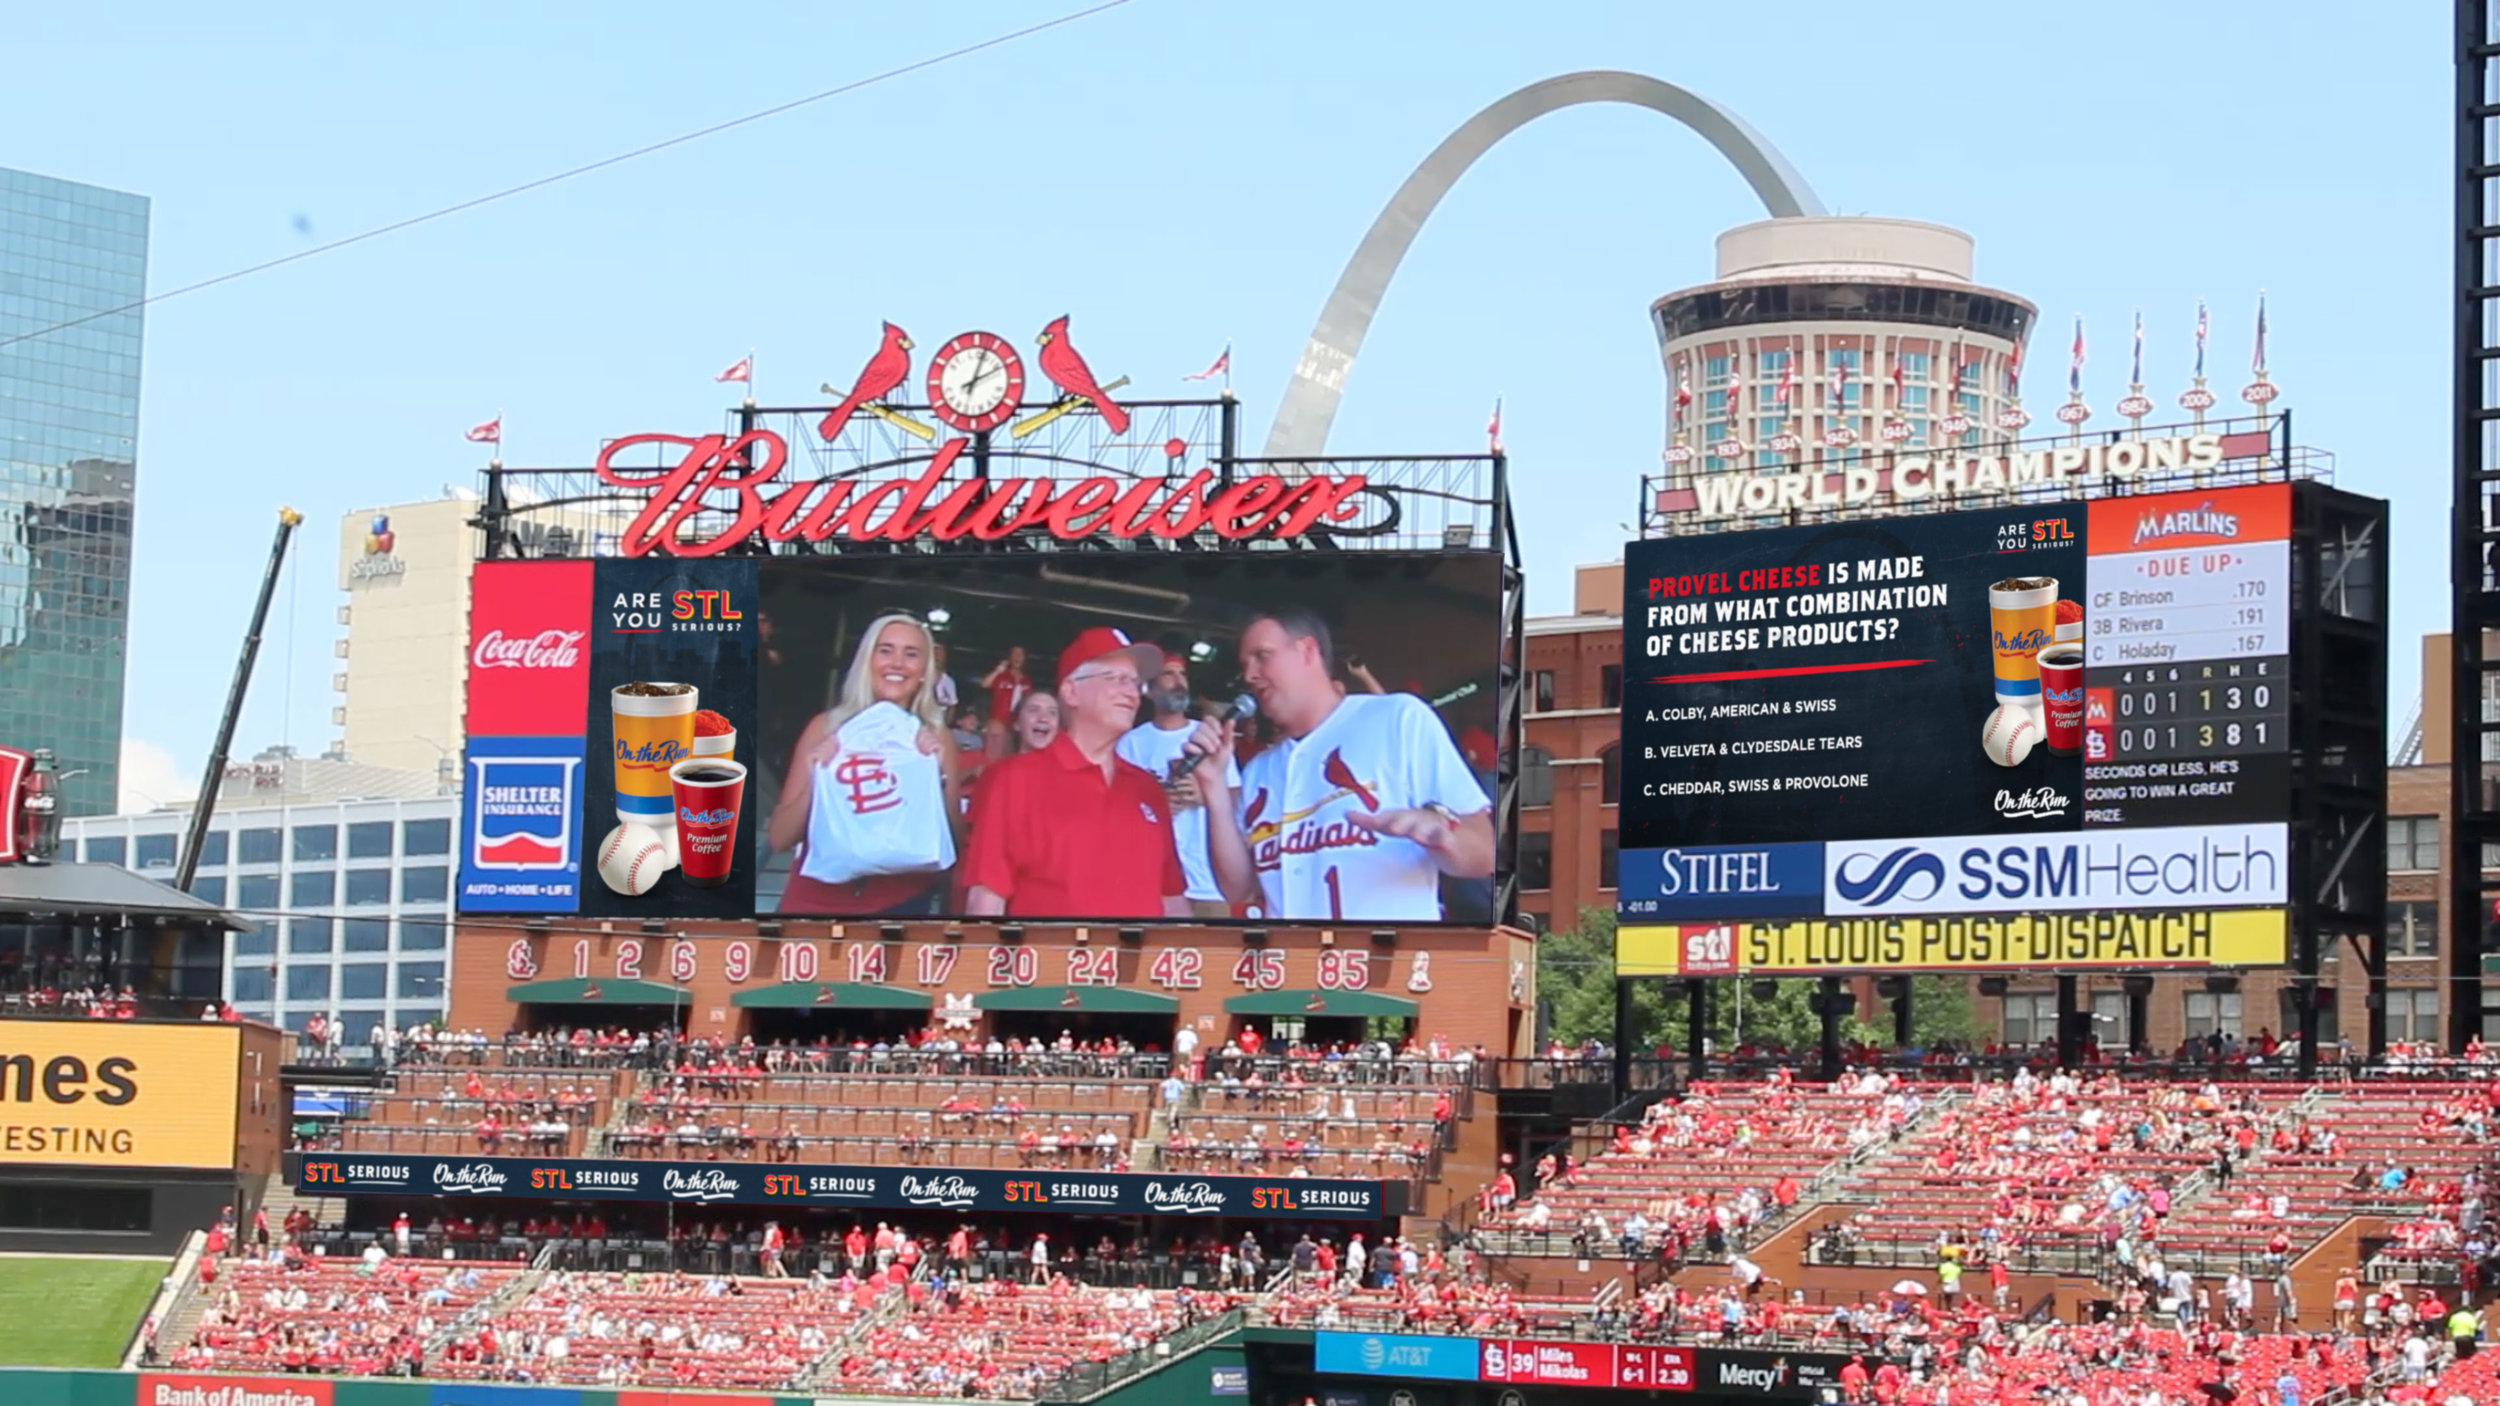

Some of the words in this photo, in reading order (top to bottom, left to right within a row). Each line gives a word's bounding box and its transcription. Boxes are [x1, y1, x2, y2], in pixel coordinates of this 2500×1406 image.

[2246, 386, 2272, 400] 2011
[1693, 467, 1879, 517] WORLD
[1892, 433, 2224, 499] CHAMPIONS
[596, 429, 1367, 558] Budweiser
[1998, 523, 2026, 536] ARE
[2032, 518, 2074, 541] STL
[2133, 508, 2239, 545] MARLINS
[1997, 537, 2026, 550] YOU
[2032, 540, 2074, 550] SERIOUS?
[1649, 571, 1732, 599] PROVEL
[1738, 564, 1820, 591] CHEESE
[1827, 562, 1849, 585] IS
[1857, 555, 1924, 582] MADE
[2148, 557, 2190, 578] DUE
[2203, 553, 2232, 573] UP
[613, 593, 661, 608] ARE
[672, 590, 742, 619] STL
[1647, 602, 1707, 628] FROM
[1715, 597, 1780, 622] WHAT
[1786, 583, 1948, 617] COMBINATION
[2094, 592, 2113, 608] CF
[2119, 591, 2174, 607] Brinson
[2233, 581, 2266, 598] .170
[612, 612, 661, 629] YOU
[672, 623, 742, 632] SERIOUS?
[2093, 619, 2112, 635] 3B
[2119, 618, 2164, 633] Rivera
[2232, 609, 2264, 625] .191
[1646, 635, 1673, 657] OF
[1679, 628, 1760, 655] CHEESE
[1767, 617, 1900, 648] PRODUCTS?
[2093, 646, 2103, 661] C
[2119, 642, 2176, 660] Holaday
[2232, 635, 2265, 652] .167
[474, 630, 585, 668] Coca-Cola
[2122, 671, 2132, 683] 4
[2146, 670, 2155, 682] 5
[2169, 669, 2178, 681] 6
[2203, 667, 2212, 678] R
[2229, 665, 2240, 677] H
[2258, 663, 2267, 675] E
[1645, 710, 1659, 722] A.
[1662, 706, 1707, 721] COLBY,
[1710, 702, 1780, 719] AMERICAN
[1783, 702, 1792, 713] &
[1795, 699, 1837, 713] SWISS
[2121, 694, 2133, 716] 0
[2144, 692, 2156, 714] 0
[2168, 691, 2176, 713] 1
[2201, 690, 2210, 711] 1
[2227, 687, 2241, 709] 3
[2254, 686, 2269, 708] 0
[1644, 747, 1657, 759] B.
[1661, 743, 1716, 758] VELVETA
[1719, 743, 1728, 755] &
[1732, 738, 1816, 755] CLYDESDALE
[1819, 735, 1863, 750] TEARS
[2121, 730, 2133, 751] 0
[2144, 728, 2156, 750] 0
[2168, 727, 2176, 748] 1
[2200, 725, 2213, 747] 3
[2227, 724, 2241, 745] 8
[2255, 722, 2267, 744] 1
[616, 739, 634, 761] On
[635, 742, 659, 763] the
[658, 740, 690, 764] Run
[2085, 764, 2146, 780] SECONDS
[2148, 763, 2168, 776] OR
[484, 787, 562, 803] SHELTER
[1643, 784, 1656, 796] C.
[1659, 781, 1725, 796] CHEDDAR,
[1728, 778, 1770, 793] SWISS
[1772, 778, 1782, 791] &
[1785, 774, 1869, 790] PROVOLONE
[2085, 787, 2127, 801] GOING
[2129, 786, 2147, 799] TO
[2150, 785, 2175, 798] WIN
[2178, 784, 2187, 796] A
[2190, 781, 2235, 795] GREAT
[484, 803, 562, 816] INSURANCE
[1994, 789, 2017, 811] On
[2017, 788, 2040, 810] the
[2036, 786, 2071, 811] Run
[687, 833, 728, 843] Premium
[692, 843, 722, 854] Coffee
[1661, 848, 1780, 895] STIFEL
[466, 884, 497, 895] AUTO
[505, 884, 539, 896] HOME
[546, 884, 573, 896] LIFE
[1687, 926, 1731, 961] stl
[1750, 922, 1795, 965] ST.
[1805, 919, 1904, 964] LOUIS
[1921, 911, 2211, 964] POST-DISPATCH
[574, 939, 589, 979] 1
[617, 940, 642, 979] 2
[671, 941, 696, 980] 6
[726, 941, 750, 981] 9
[780, 942, 818, 982] 10
[849, 943, 886, 983] 14
[917, 944, 957, 984] 17
[988, 945, 1038, 987] 20
[1067, 946, 1118, 988] 24
[1150, 947, 1202, 989] 42
[1233, 948, 1285, 990] 45
[1317, 949, 1368, 991] 85
[305, 1162, 345, 1183] STL
[348, 1165, 410, 1179] SERIOUS
[433, 1163, 457, 1184] On
[456, 1164, 478, 1184] the
[475, 1163, 507, 1187] Run
[531, 1168, 572, 1189] STL
[575, 1171, 639, 1185] SERIOUS
[663, 1169, 686, 1190] On
[686, 1170, 709, 1190] the
[706, 1169, 740, 1193] Run
[764, 1174, 806, 1196] STL
[810, 1177, 875, 1192] SERIOUS
[1004, 1181, 1048, 1202] STL
[1051, 1183, 1119, 1198] SERIOUS
[1144, 1182, 1169, 1203] On
[1168, 1182, 1194, 1204] the
[1190, 1182, 1226, 1206] Run
[1252, 1187, 1297, 1209] STL
[1301, 1190, 1370, 1205] SERIOUS
[1388, 1346, 1432, 1366] AT&T
[1512, 1353, 1534, 1373] 39
[1539, 1347, 1574, 1363] Miles
[1539, 1363, 1588, 1380] Mikolas
[1622, 1367, 1644, 1382] 6-1
[1658, 1368, 1688, 1385] 2.30
[1720, 1363, 1776, 1392] Mercy
[155, 1384, 207, 1406] Bank
[231, 1387, 316, 1406] America
